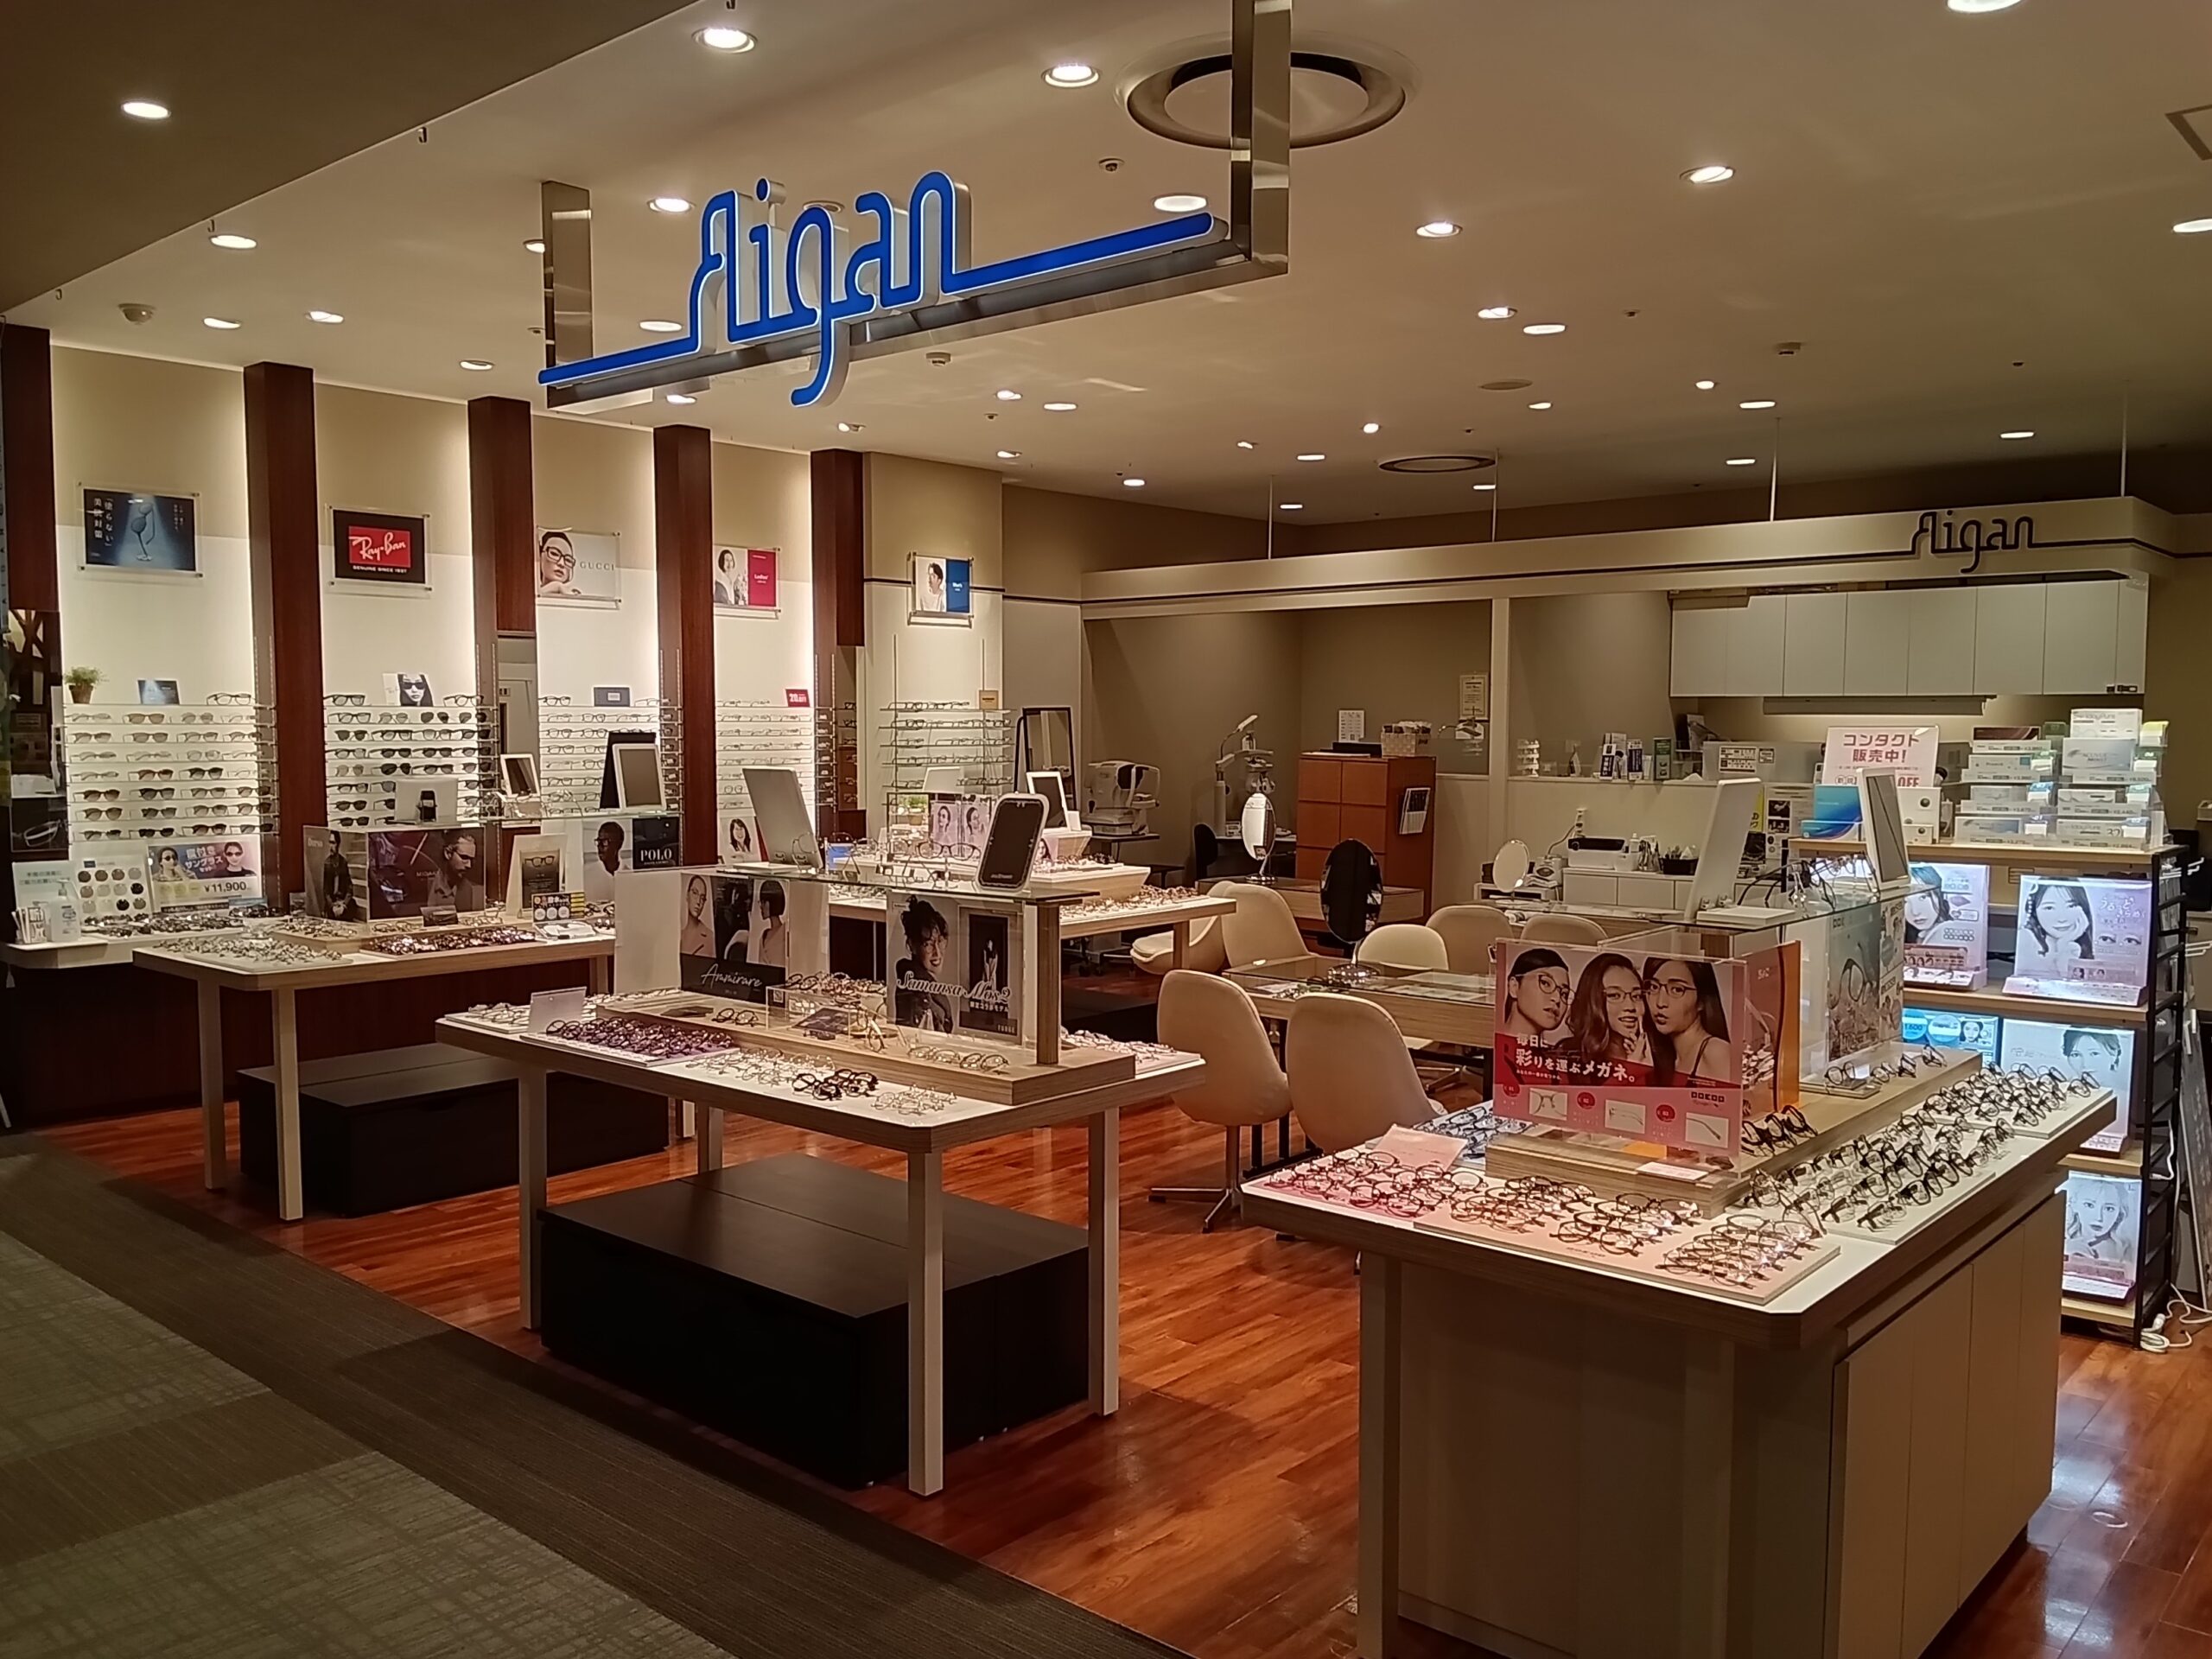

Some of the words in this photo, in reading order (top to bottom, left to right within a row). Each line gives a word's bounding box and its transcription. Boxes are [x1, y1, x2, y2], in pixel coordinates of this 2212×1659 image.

[690, 171, 956, 406] Aigan
[1910, 510, 2034, 574] Aigan
[579, 561, 614, 571] GUCCI
[1843, 734, 1920, 747] コンタクト
[1853, 749, 1907, 763] 販売中!
[640, 849, 672, 862] POLO
[204, 881, 247, 893] ¥11,900
[1516, 1033, 1549, 1048] 毎日に
